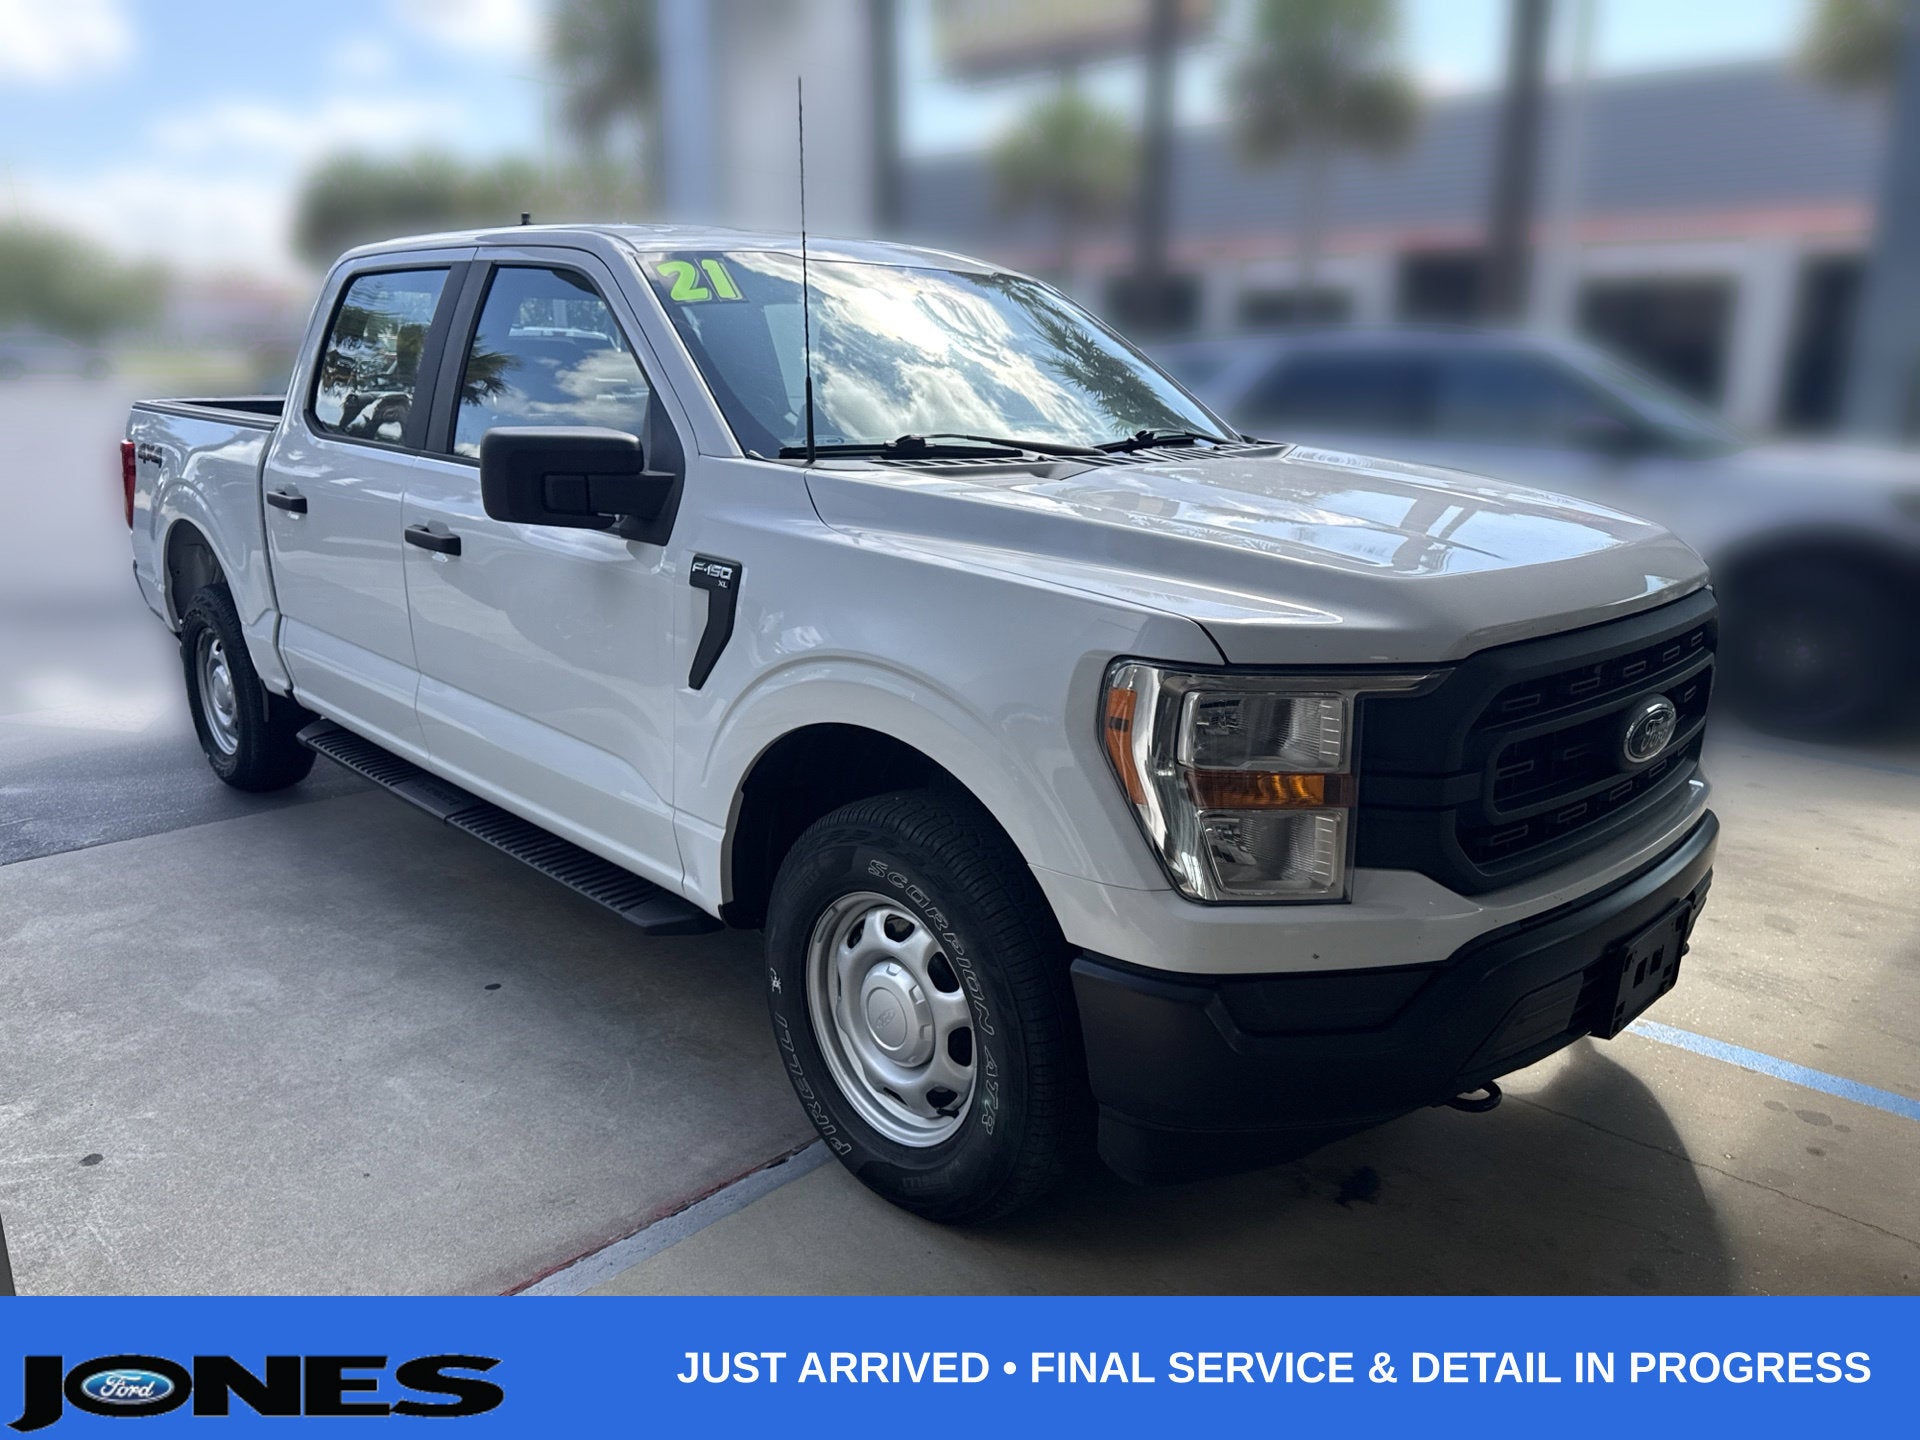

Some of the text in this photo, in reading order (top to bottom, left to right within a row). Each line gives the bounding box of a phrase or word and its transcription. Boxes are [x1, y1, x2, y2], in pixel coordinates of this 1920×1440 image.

[656, 259, 743, 302] 21
[692, 562, 733, 580] F-150
[718, 580, 728, 589] XL
[868, 859, 999, 1135] SCORPION ATR
[774, 1011, 852, 1156] PIRELLI
